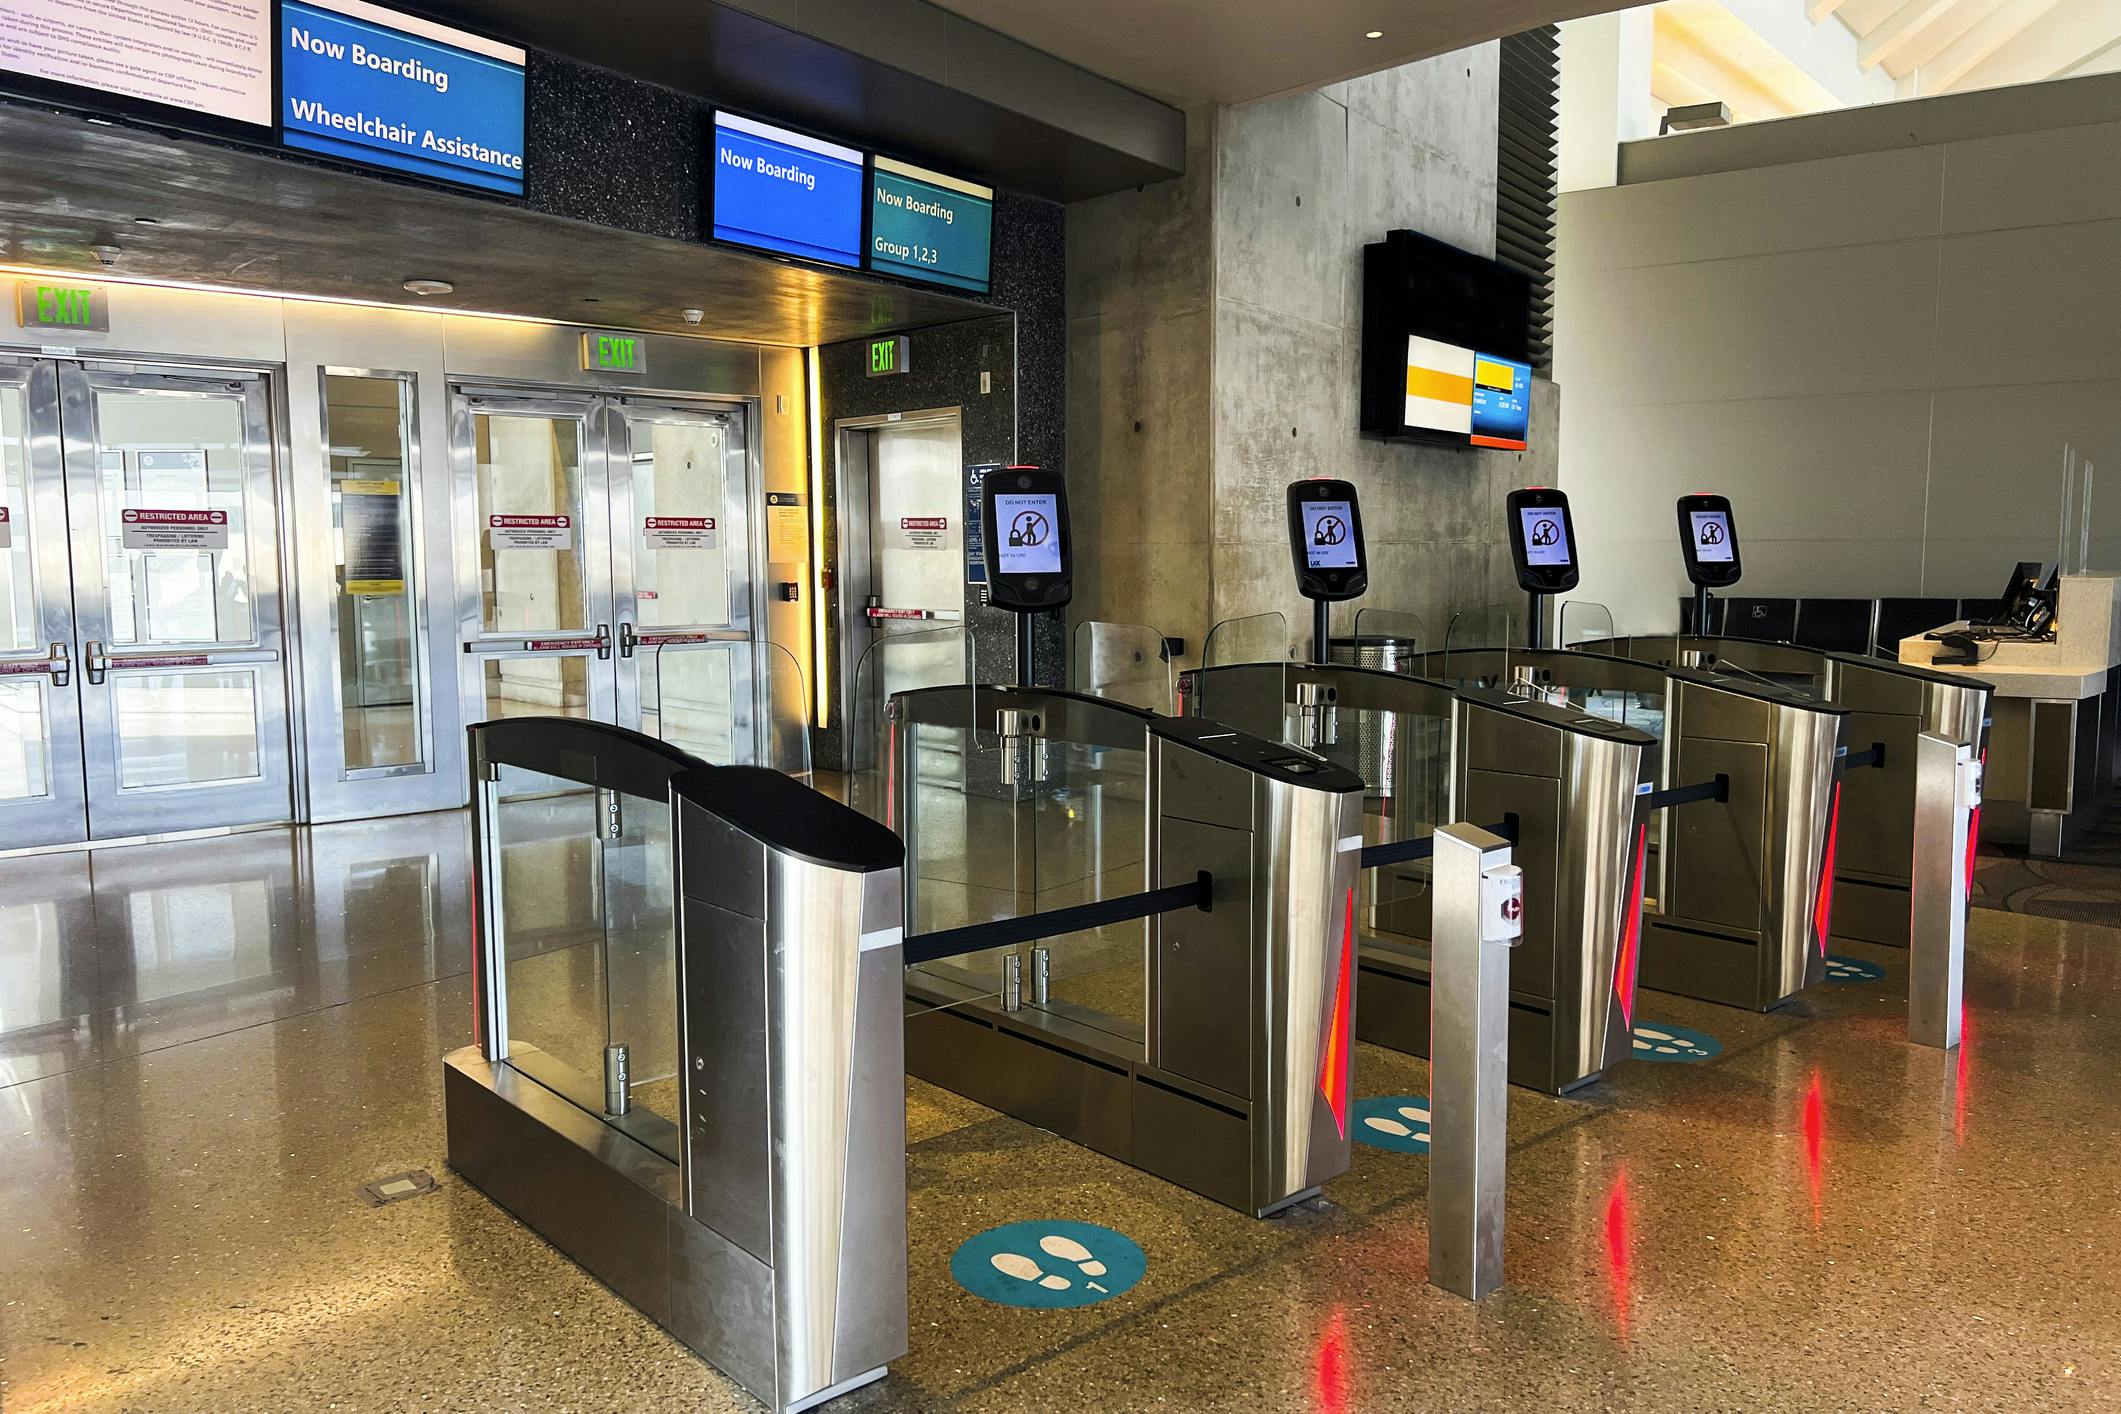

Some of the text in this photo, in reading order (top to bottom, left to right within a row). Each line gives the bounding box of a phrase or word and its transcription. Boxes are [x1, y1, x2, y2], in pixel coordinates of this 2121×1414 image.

[290, 26, 450, 92] Now Boarding
[290, 97, 523, 170] Wheelchair Assistance
[720, 148, 816, 191] Now Boarding
[877, 188, 954, 224] Now Boarding
[874, 237, 938, 264] Group 1,2,3
[37, 286, 91, 326] EXIT
[598, 336, 634, 368] EXIT
[872, 340, 894, 372] EXIT
[140, 512, 186, 520] RESTRICTED
[1086, 1282, 1108, 1294] 1
